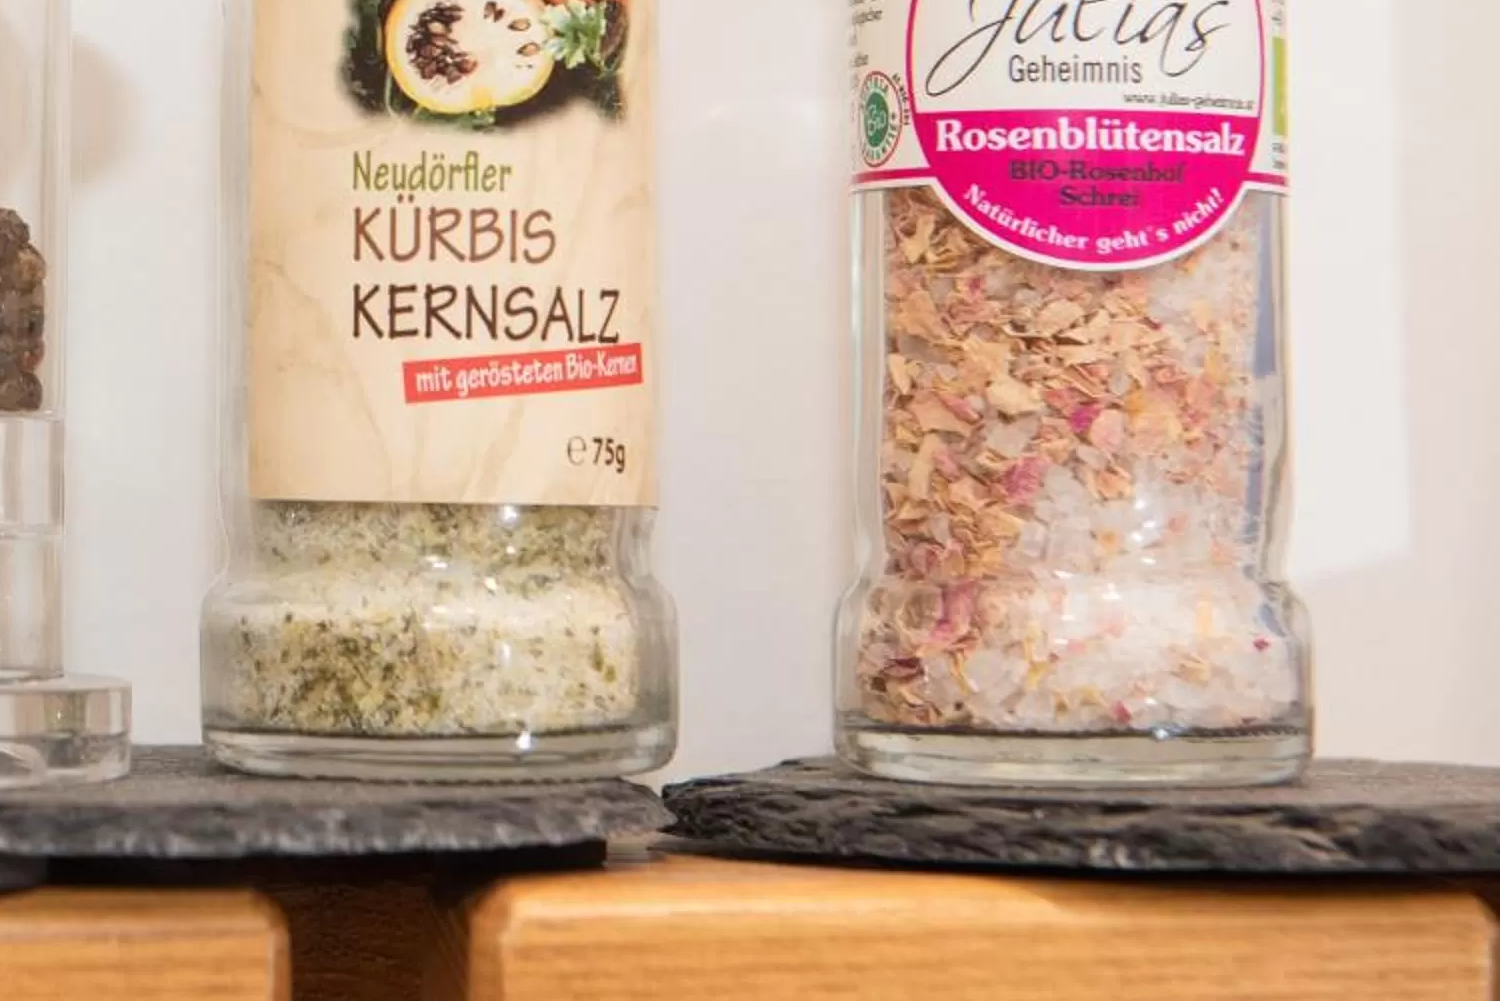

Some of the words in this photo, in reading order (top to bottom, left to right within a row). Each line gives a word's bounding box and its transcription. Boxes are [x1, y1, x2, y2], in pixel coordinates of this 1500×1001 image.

[1008, 53, 1144, 84] Geheimnis
[935, 116, 1246, 156] Rosenblütensalz
[352, 150, 512, 194] Neudörfler
[1009, 159, 1186, 183] BIO-Rosenhof
[352, 194, 557, 264] KÜRBIS
[963, 183, 1089, 250] Natürlicher
[1172, 186, 1226, 236] nicht!
[352, 284, 621, 344] KERNSALZ
[415, 366, 453, 393] mit
[455, 356, 563, 397] gerösteten
[591, 436, 626, 475] 75g
